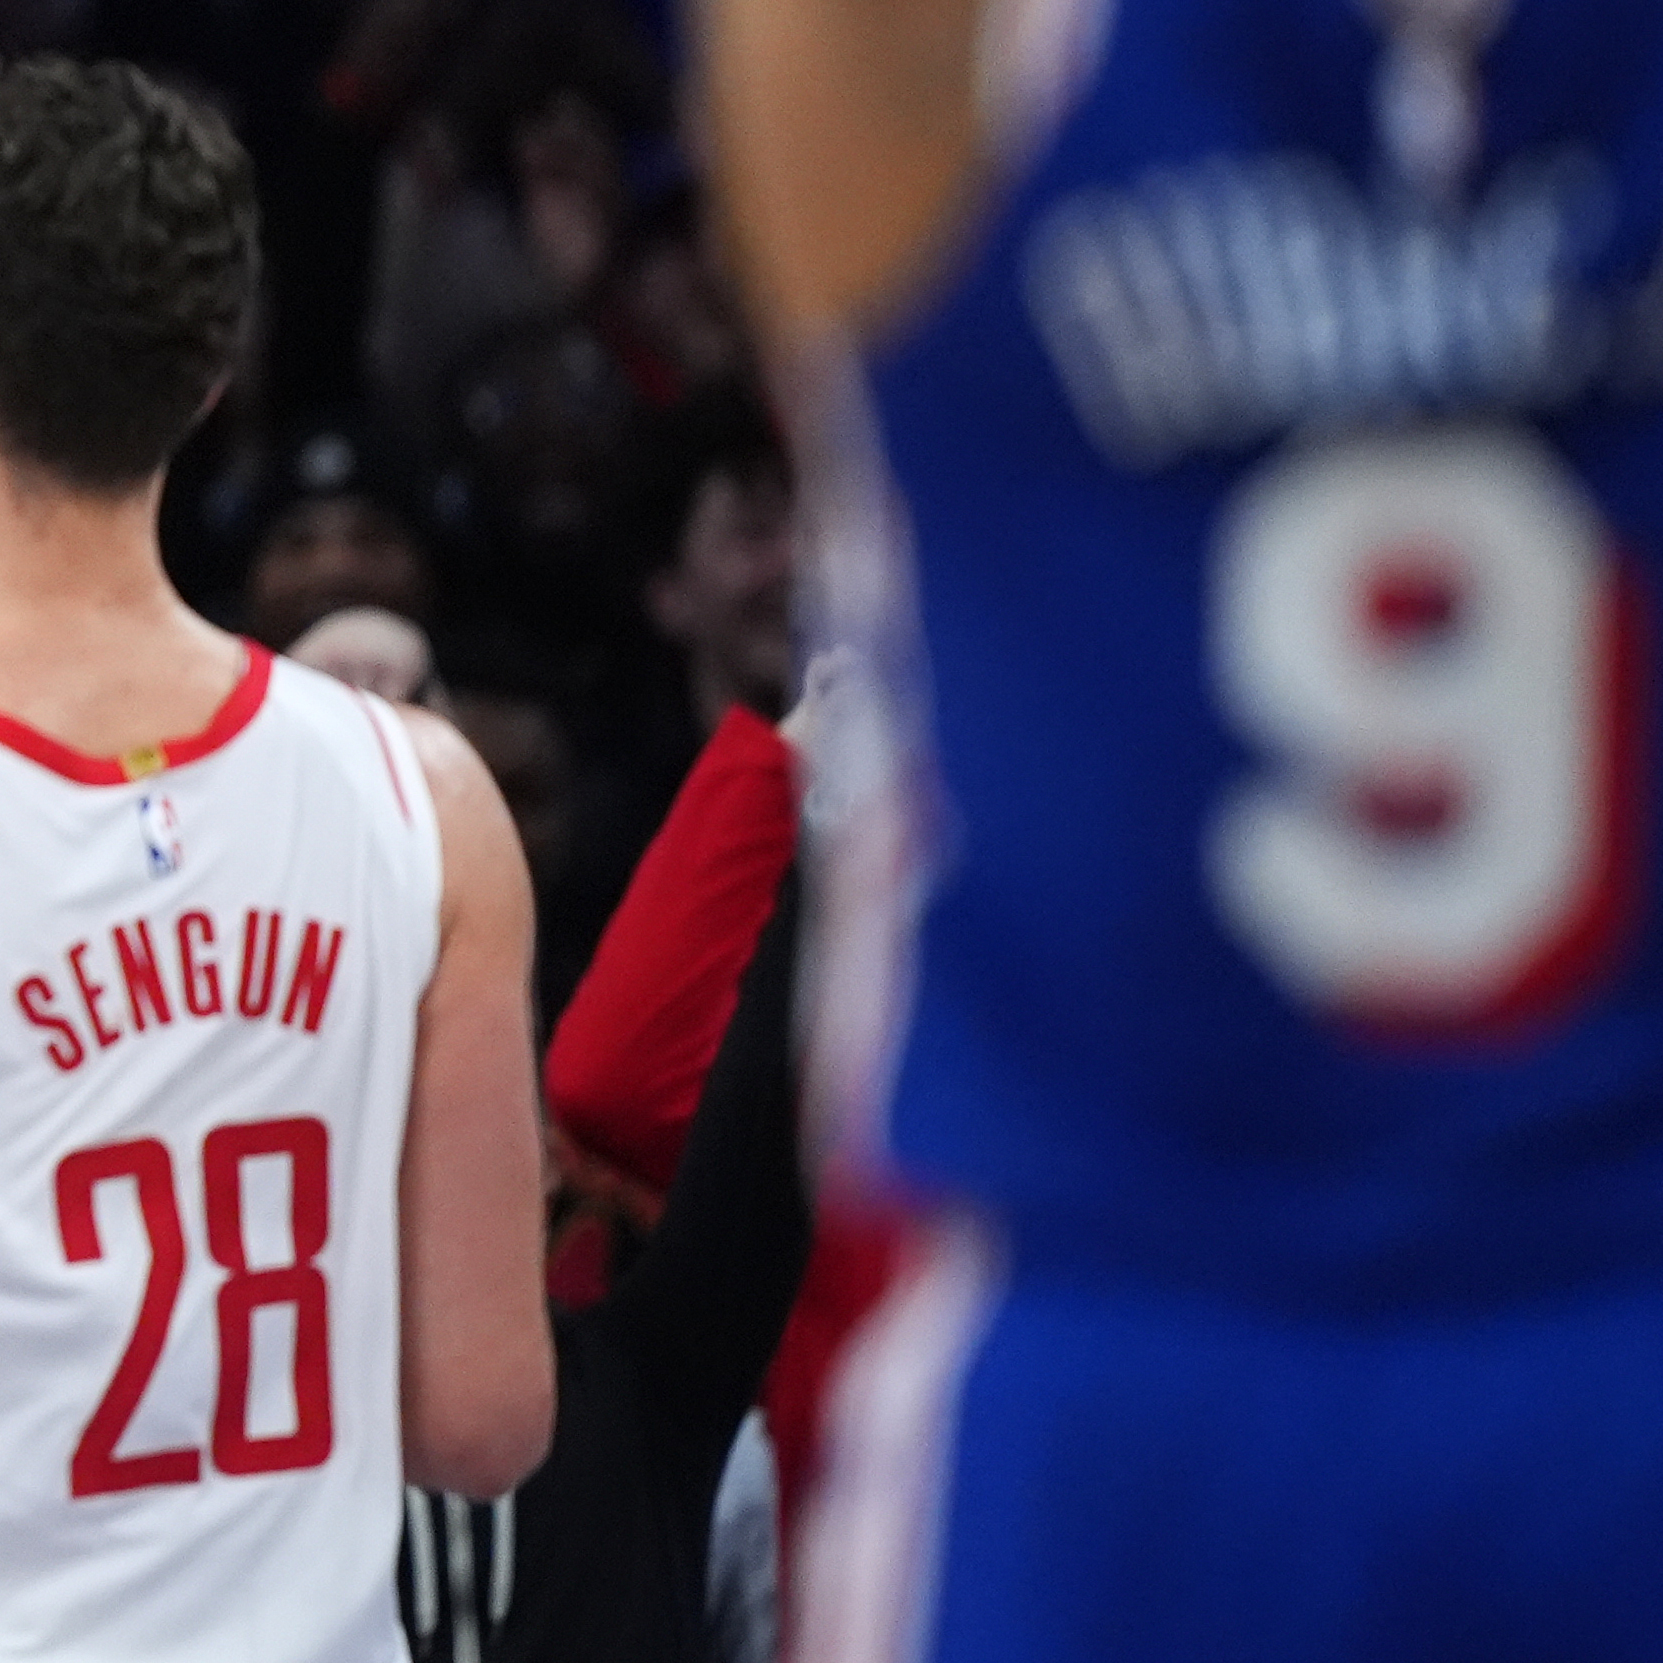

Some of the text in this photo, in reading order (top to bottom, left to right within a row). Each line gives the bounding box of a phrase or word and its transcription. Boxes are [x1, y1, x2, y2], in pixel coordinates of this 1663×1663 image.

[1200, 421, 1641, 1051] 9
[14, 907, 350, 1074] SENGUN
[55, 1115, 336, 1499] 28
